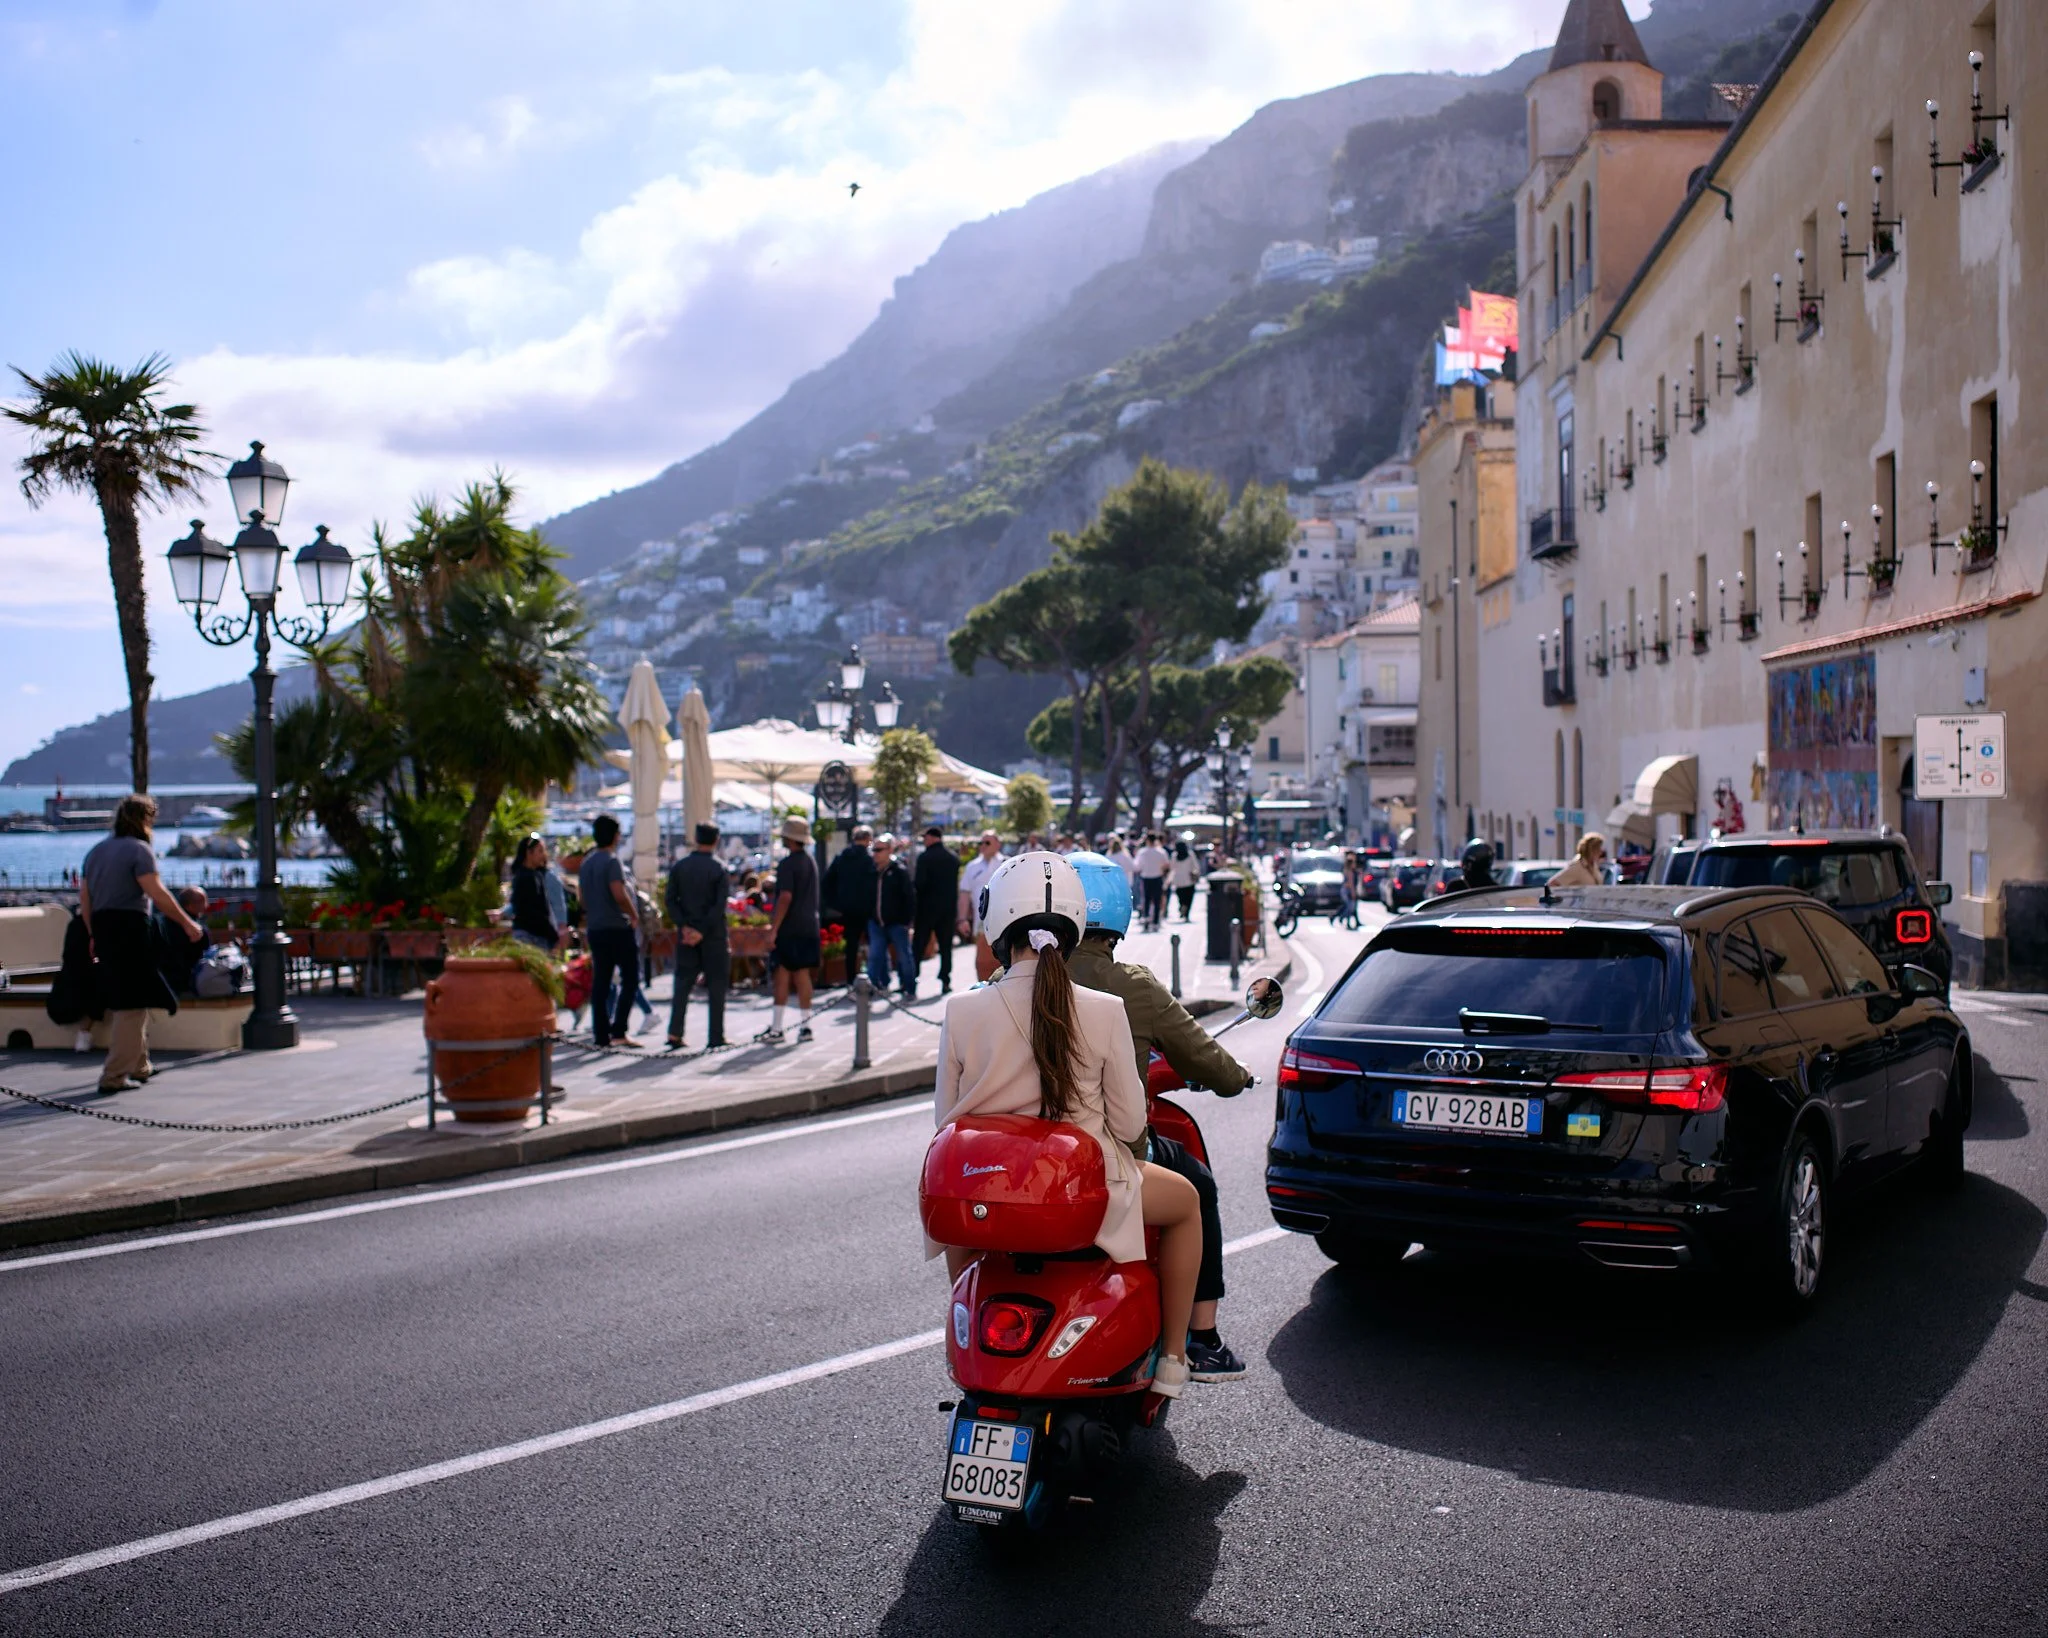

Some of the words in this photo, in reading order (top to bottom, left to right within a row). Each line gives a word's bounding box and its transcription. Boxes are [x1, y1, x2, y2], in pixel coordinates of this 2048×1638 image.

[1409, 1095, 1438, 1122] GV
[1448, 1097, 1525, 1129] 928AB
[962, 1162, 1007, 1177] Vespa
[971, 1425, 1002, 1456] FF
[950, 1462, 1024, 1500] 68083
